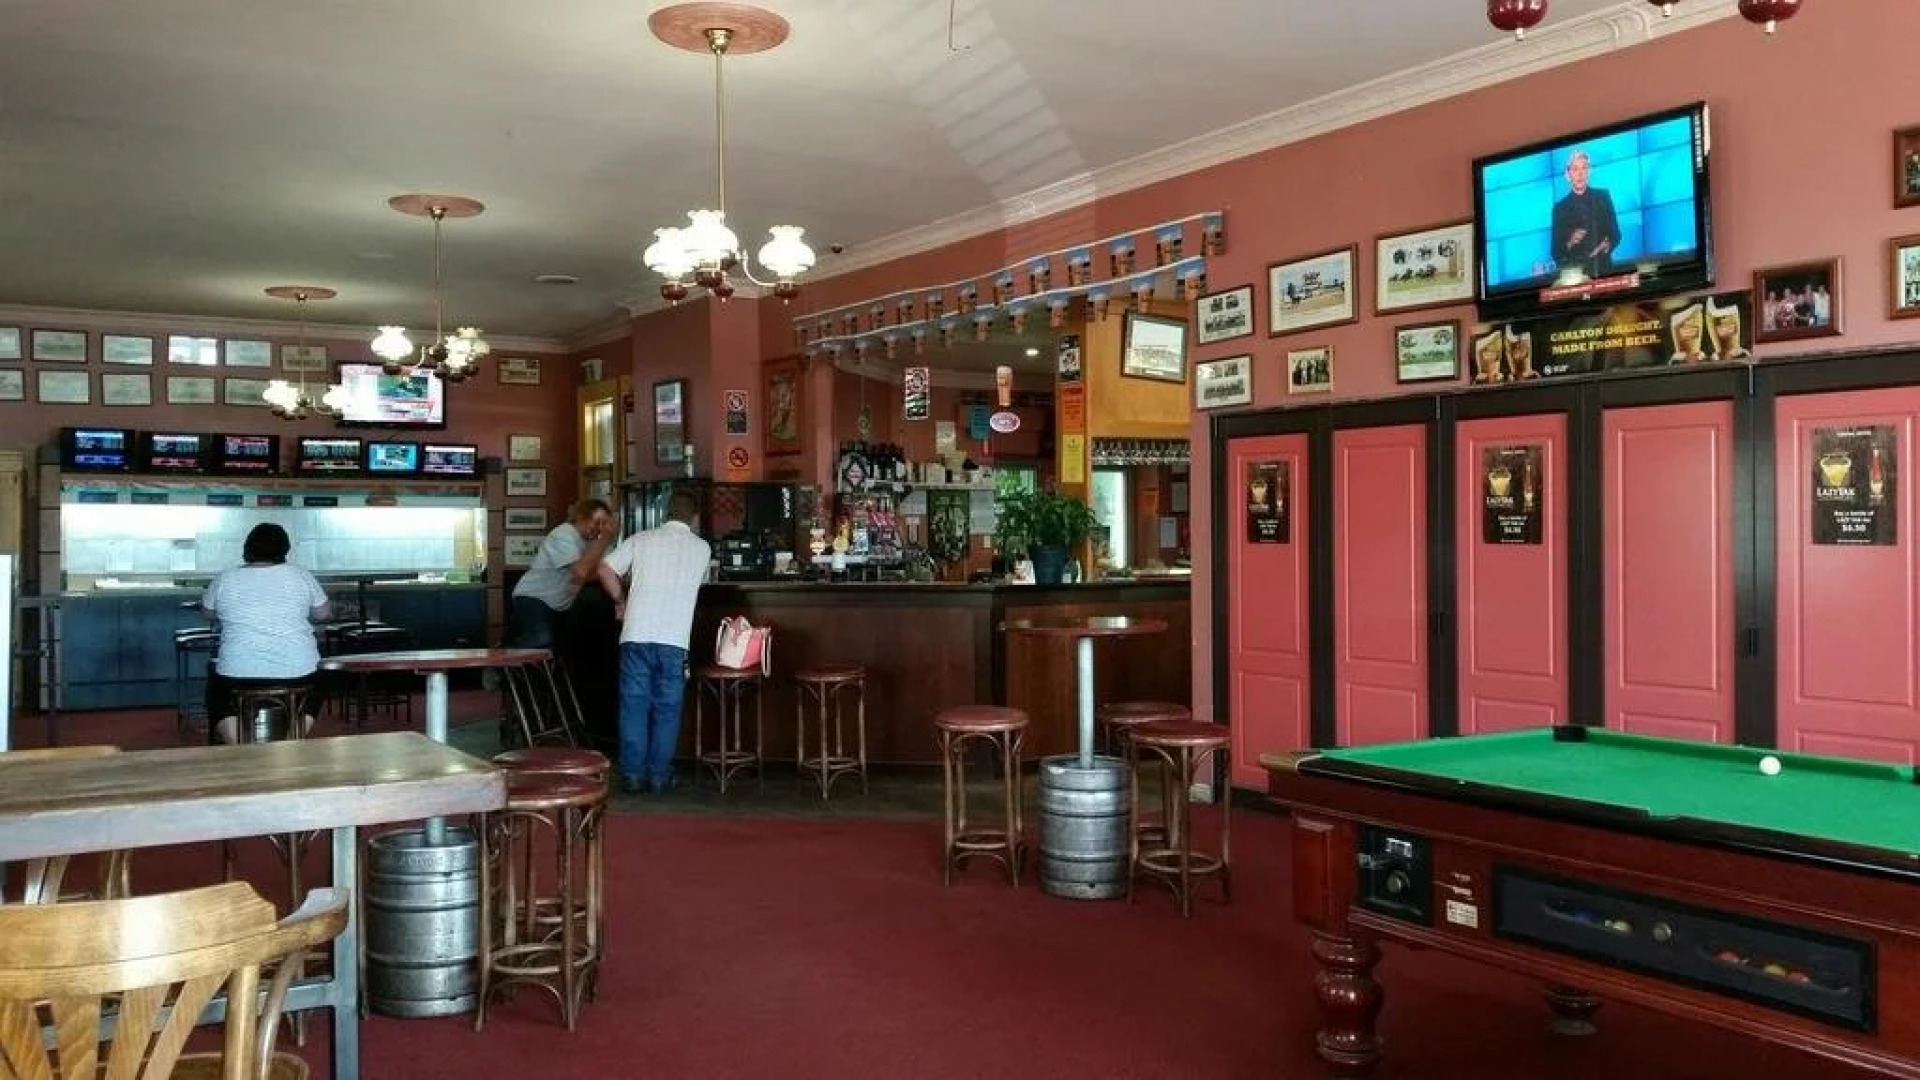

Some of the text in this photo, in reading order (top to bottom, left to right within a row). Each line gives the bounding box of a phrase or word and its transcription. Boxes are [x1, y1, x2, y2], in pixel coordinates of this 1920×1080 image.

[1550, 327, 1604, 342] CARLTON
[1552, 341, 1587, 355] MADE
[1589, 337, 1623, 351] FROM
